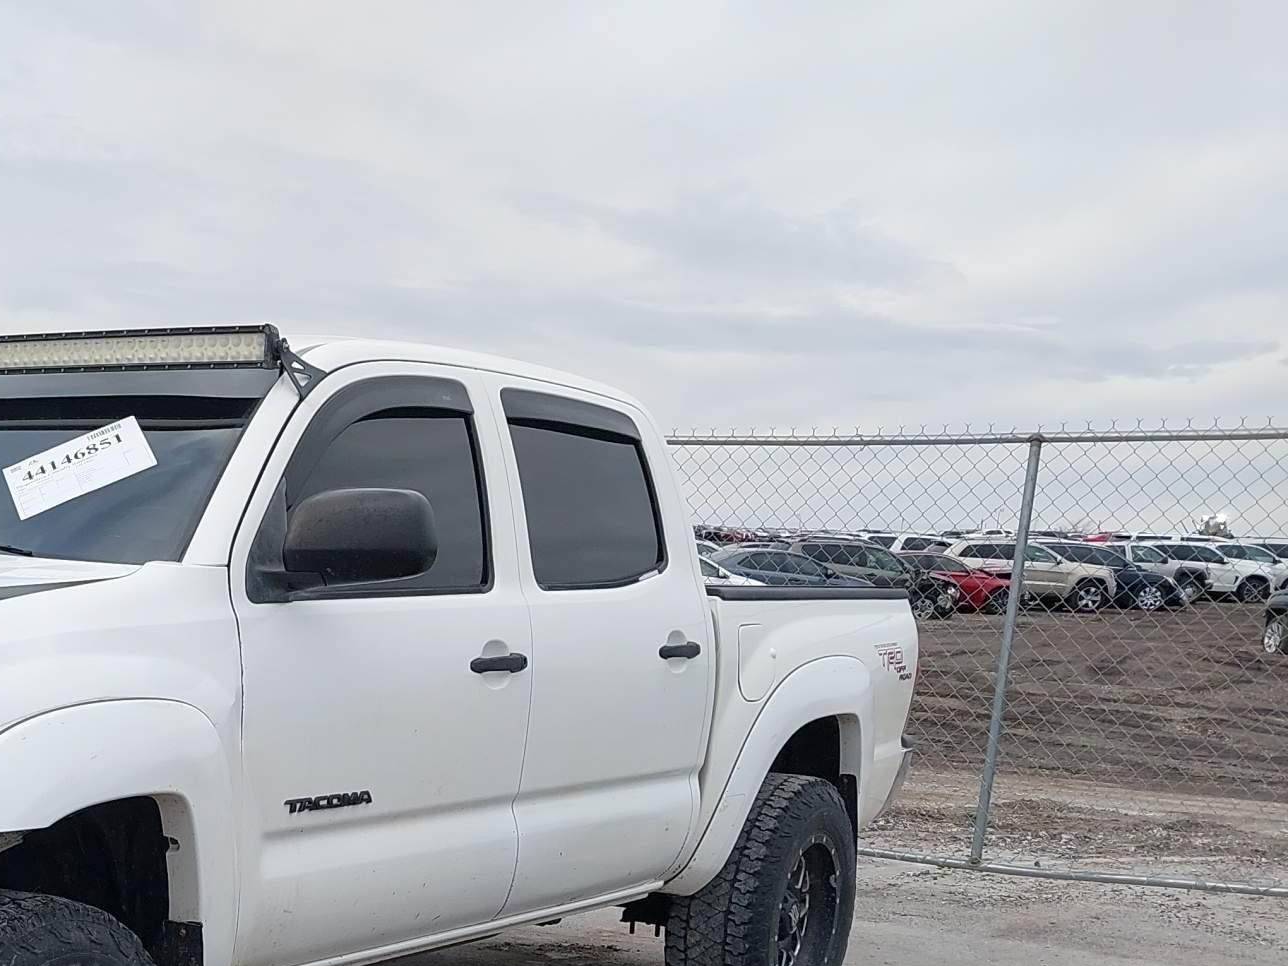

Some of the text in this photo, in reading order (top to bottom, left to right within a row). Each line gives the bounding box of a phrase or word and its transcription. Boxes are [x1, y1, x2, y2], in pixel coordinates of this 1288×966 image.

[22, 433, 123, 481] 44146851
[878, 647, 903, 671] TRD
[284, 790, 372, 814] TACOMA
